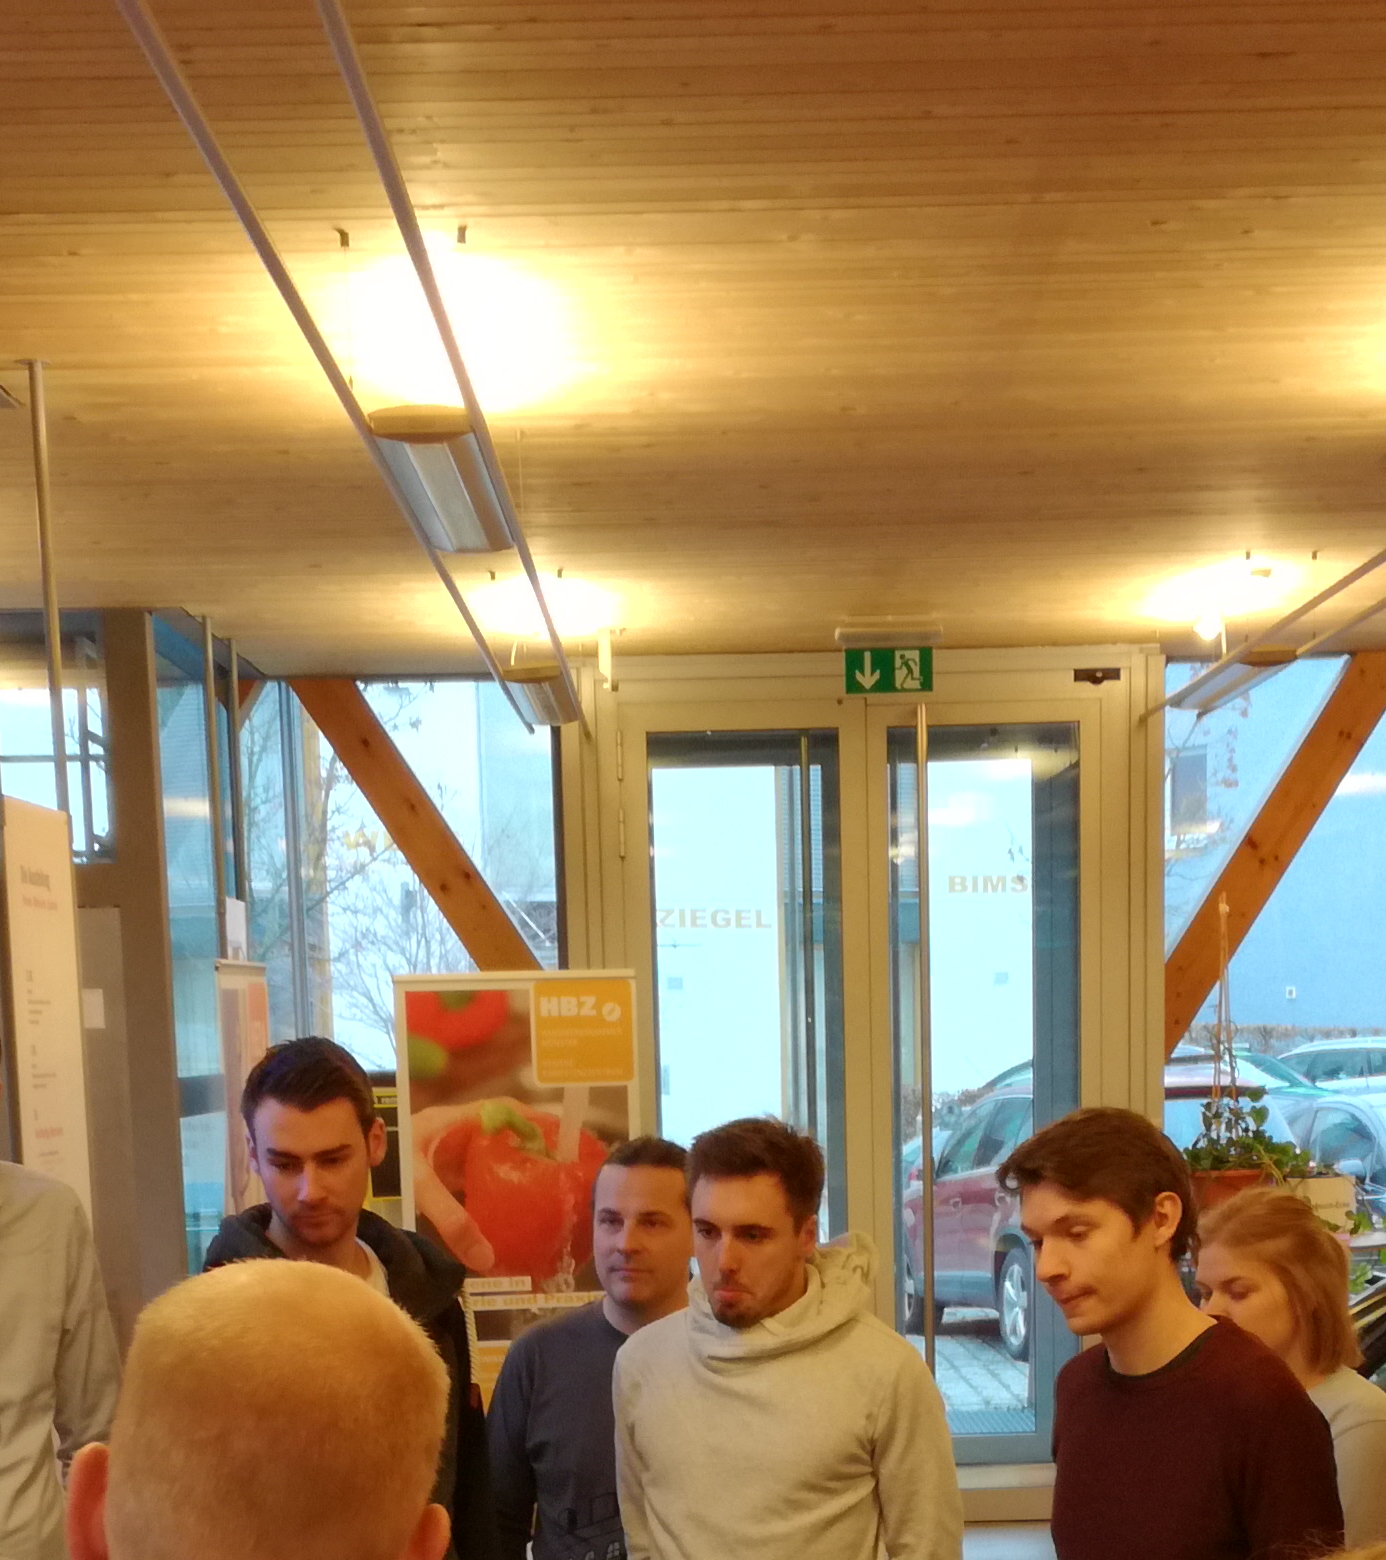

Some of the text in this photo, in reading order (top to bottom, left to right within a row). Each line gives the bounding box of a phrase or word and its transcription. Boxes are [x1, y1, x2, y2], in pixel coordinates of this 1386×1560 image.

[948, 875, 1029, 894] BIMS
[656, 908, 772, 929] ZIEGEL
[540, 996, 597, 1017] HBZ
